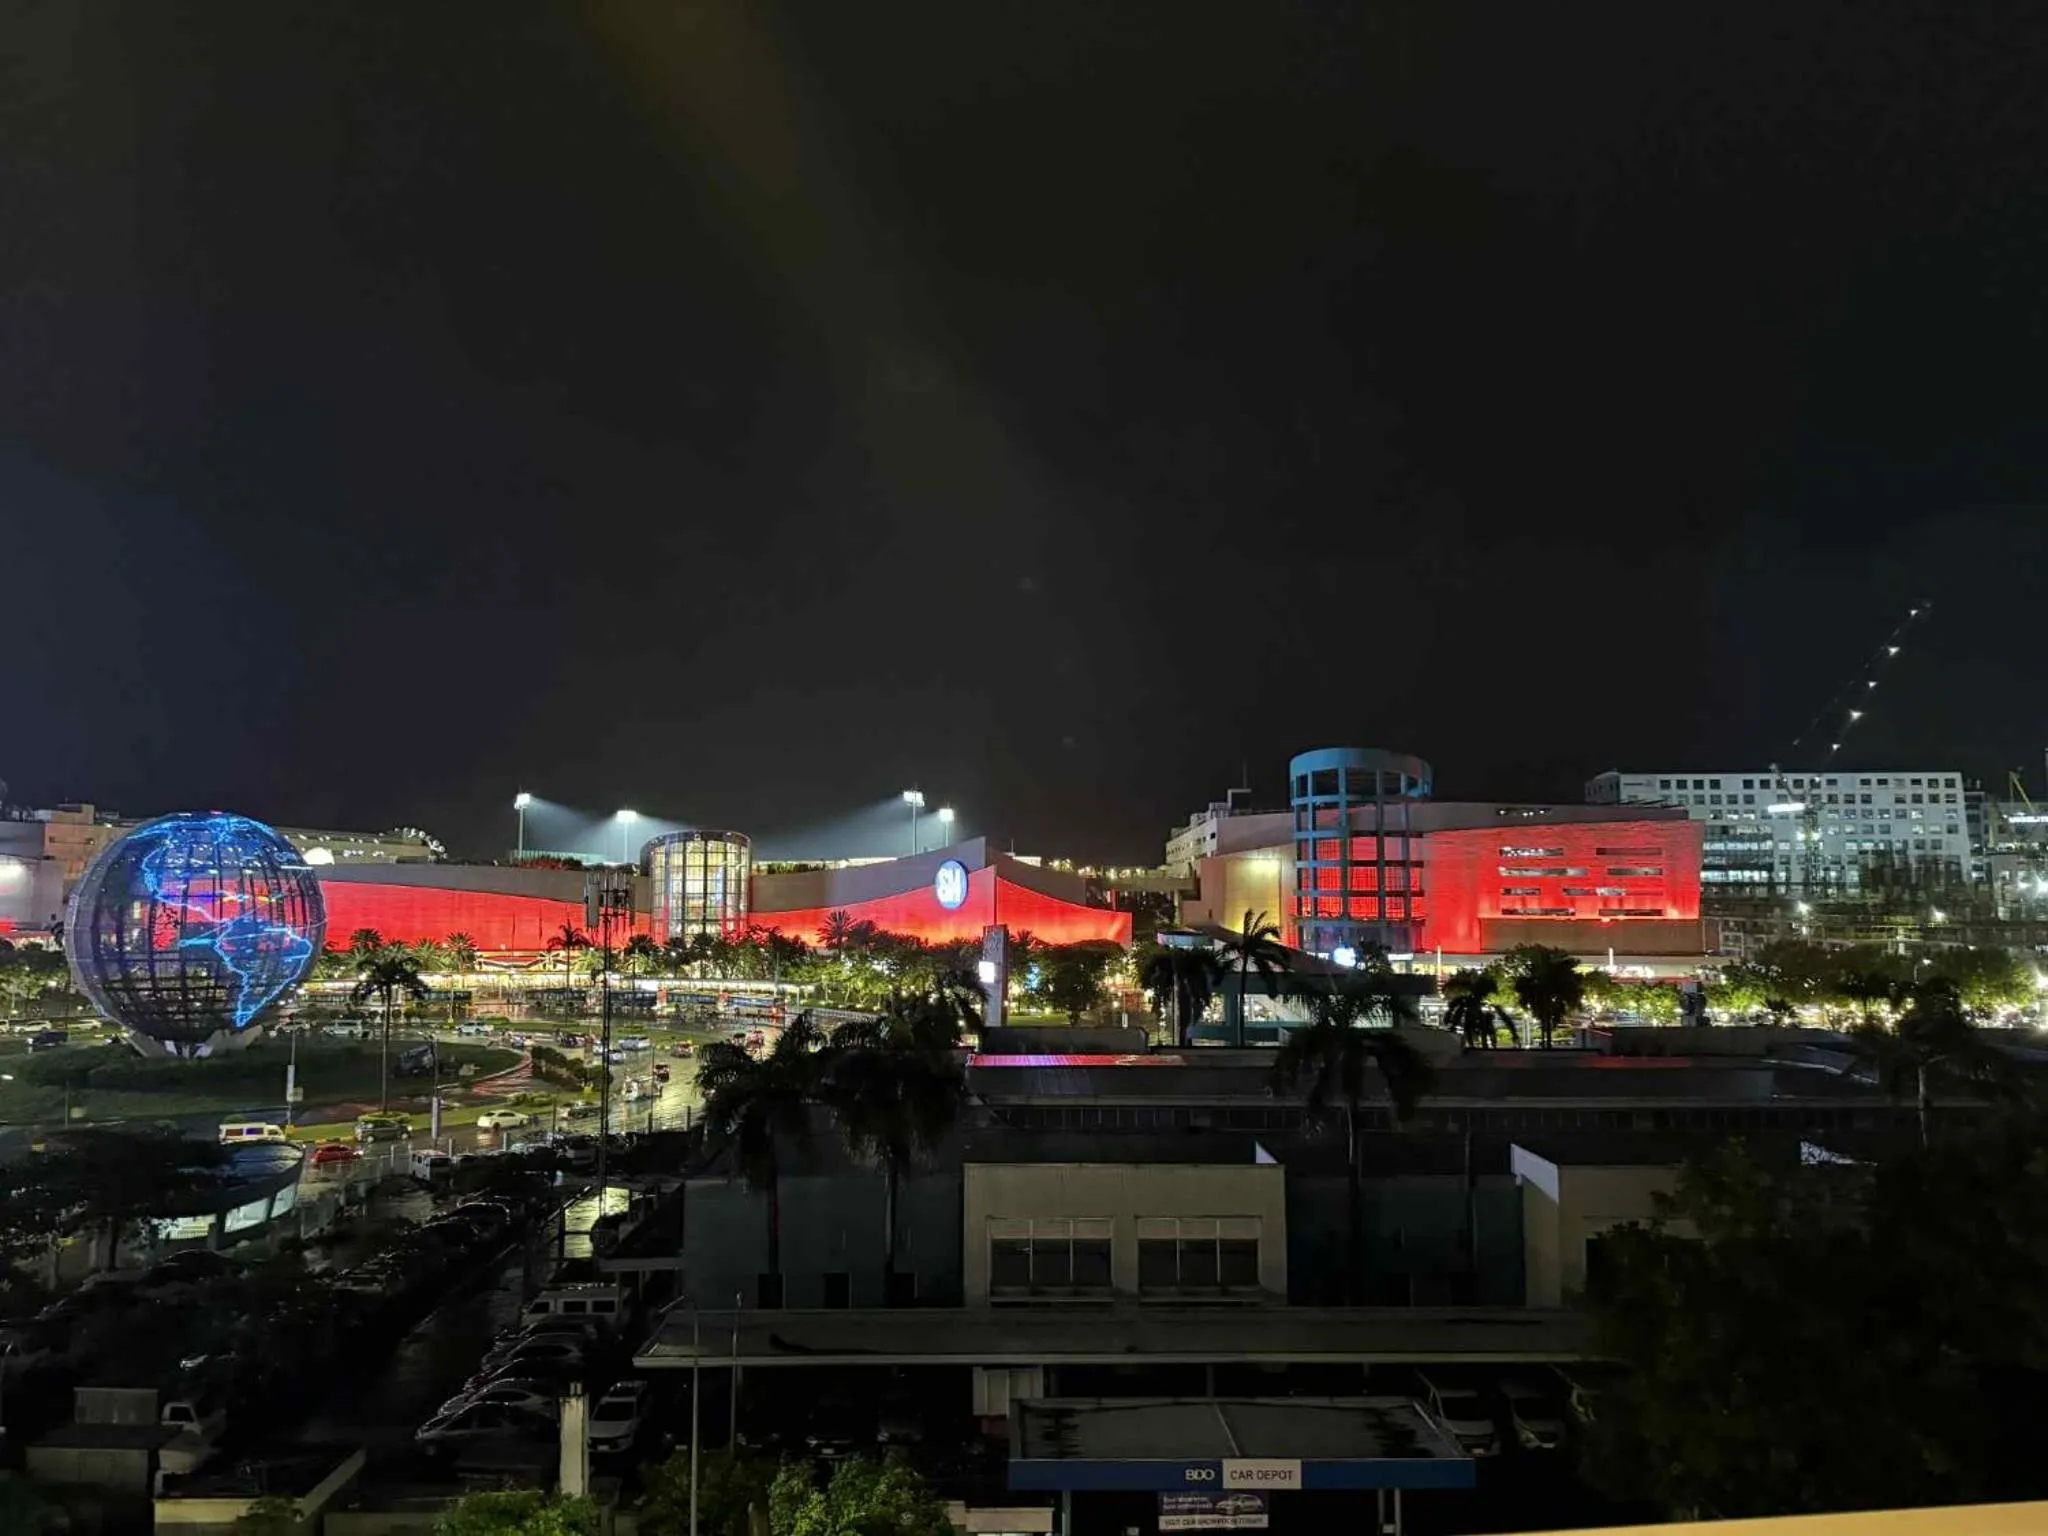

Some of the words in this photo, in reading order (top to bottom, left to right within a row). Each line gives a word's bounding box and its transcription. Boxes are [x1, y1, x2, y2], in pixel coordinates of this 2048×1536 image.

[937, 867, 961, 902] SM
[1186, 1470, 1215, 1481] BDO
[1230, 1470, 1253, 1481] CAR
[1256, 1470, 1294, 1481] DEPOT
